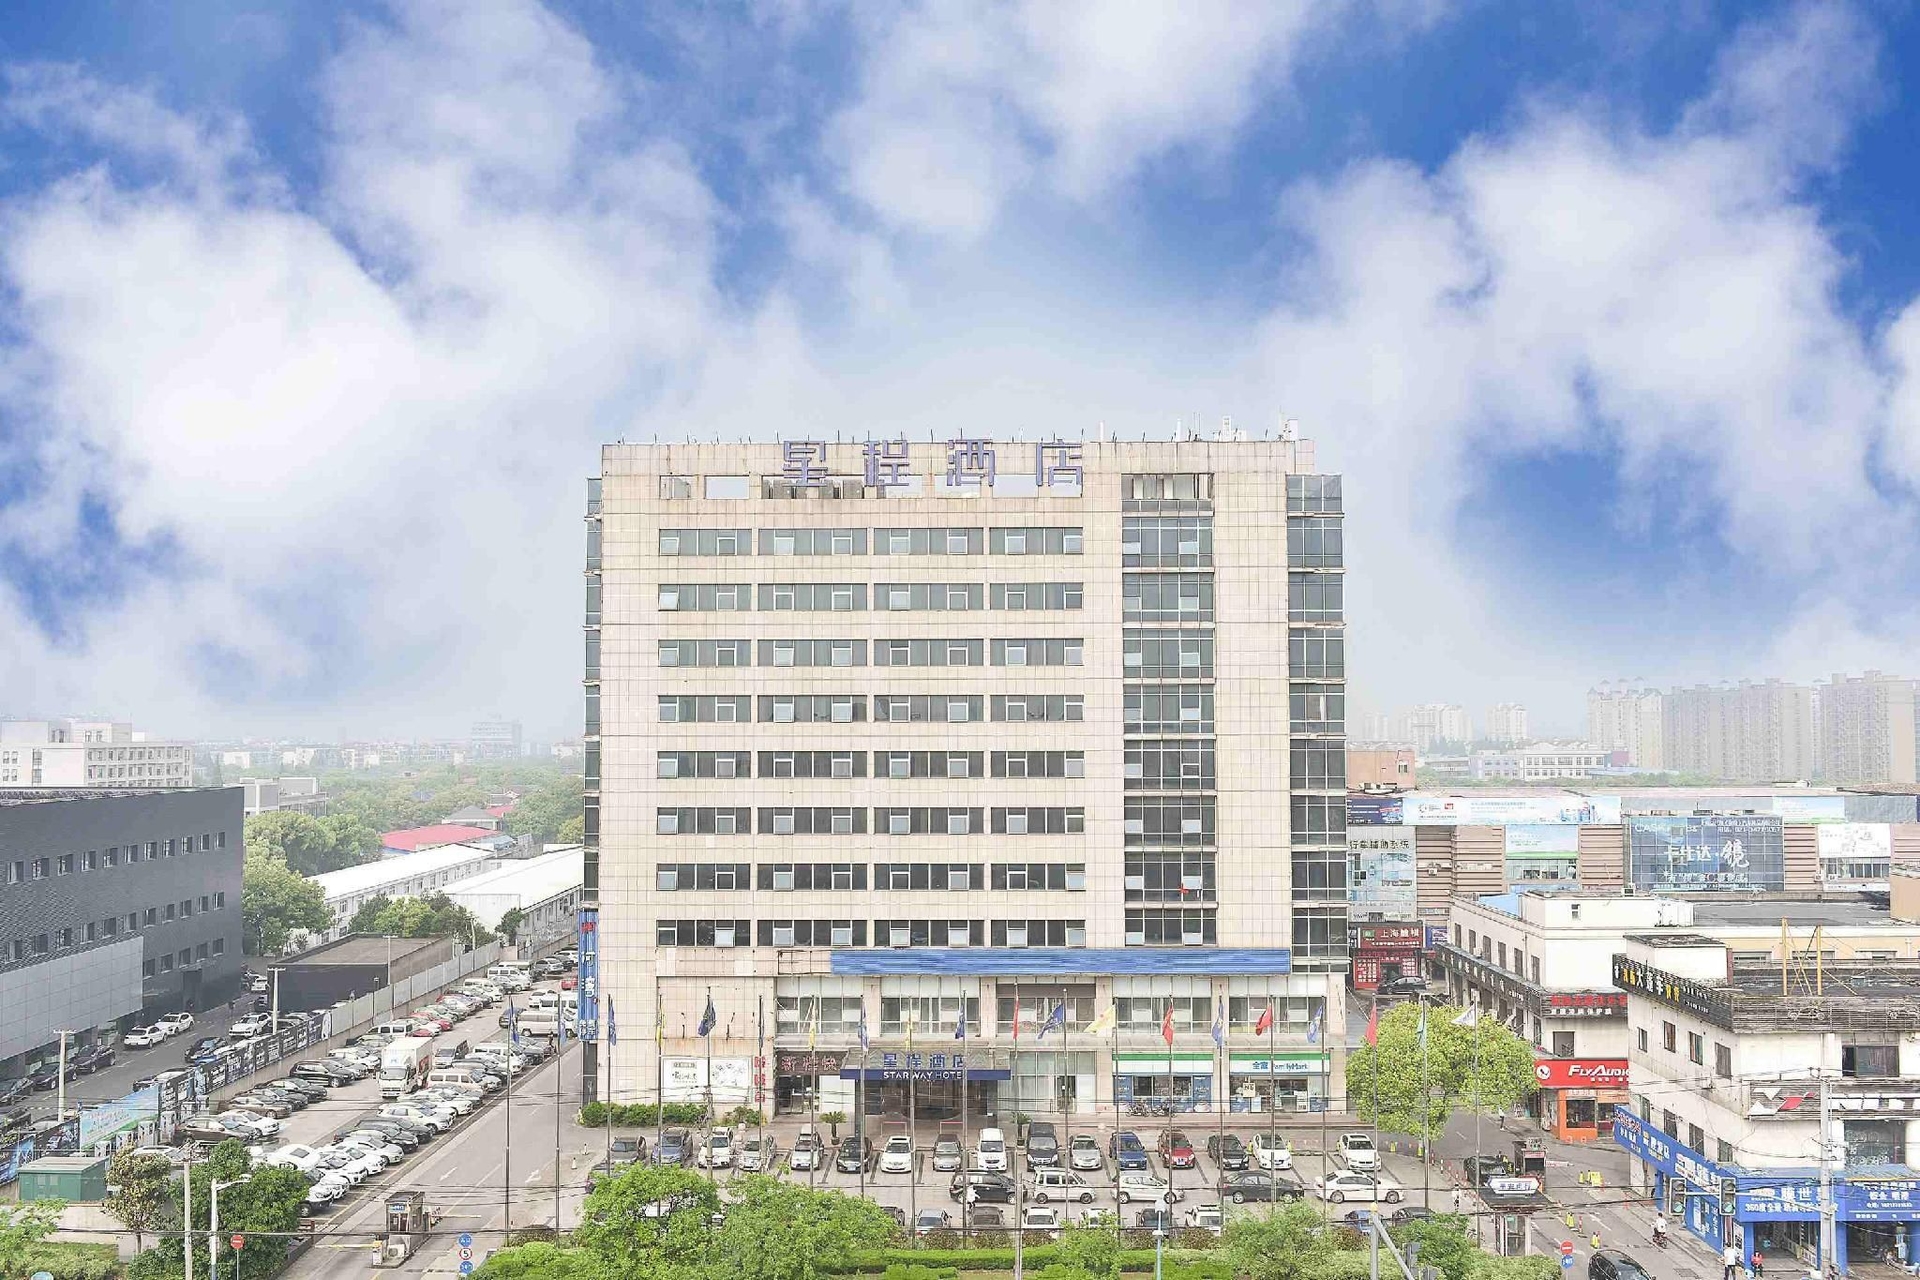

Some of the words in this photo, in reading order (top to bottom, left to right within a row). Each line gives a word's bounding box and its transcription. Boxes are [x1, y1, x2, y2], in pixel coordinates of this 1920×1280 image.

[783, 439, 1082, 486] 星程酒店
[883, 1053, 965, 1069] 星程酒店
[1272, 1062, 1308, 1071] amilyMart
[935, 1071, 963, 1080] HOTE
